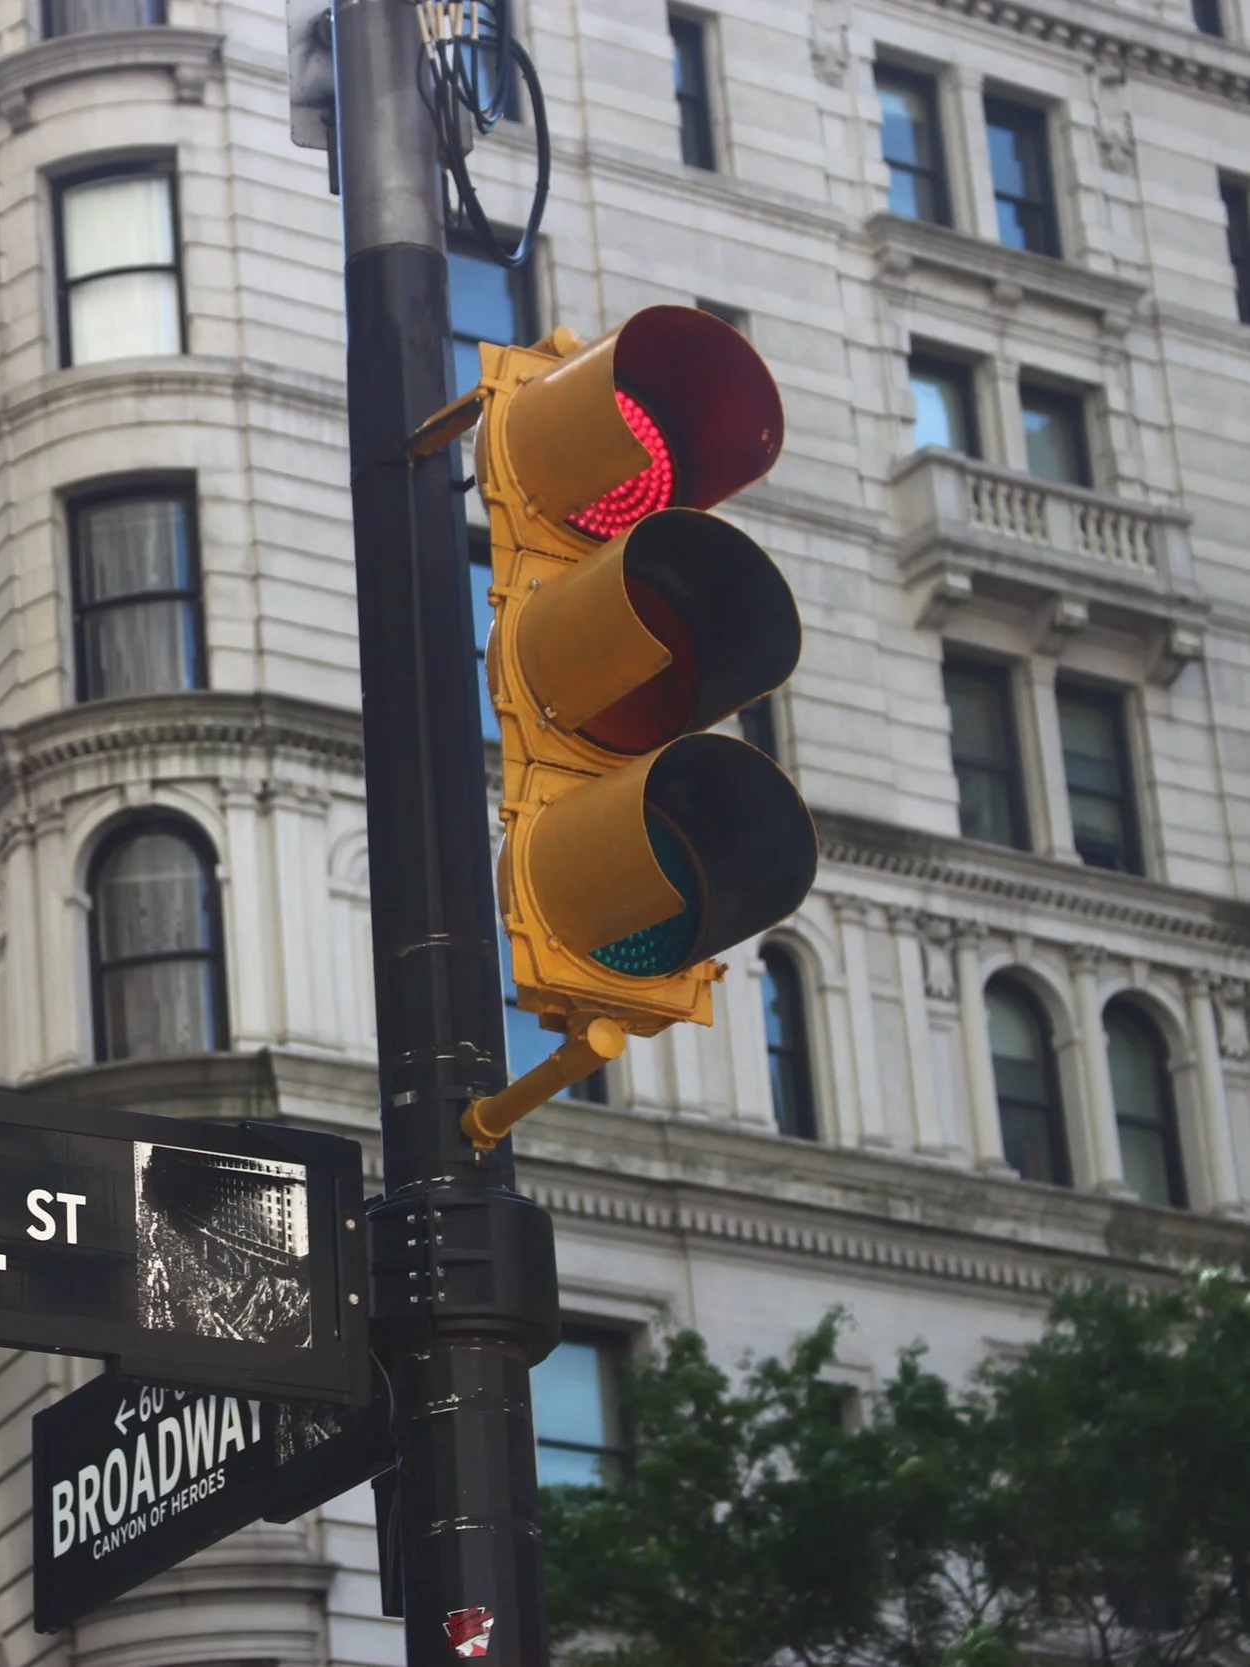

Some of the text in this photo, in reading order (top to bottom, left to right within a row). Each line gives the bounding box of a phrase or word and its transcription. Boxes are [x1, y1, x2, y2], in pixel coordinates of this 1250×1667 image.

[26, 1188, 87, 1245] ST
[52, 1395, 261, 1559] BROADWAY
[93, 1468, 226, 1560] CANYON OF HEROES
